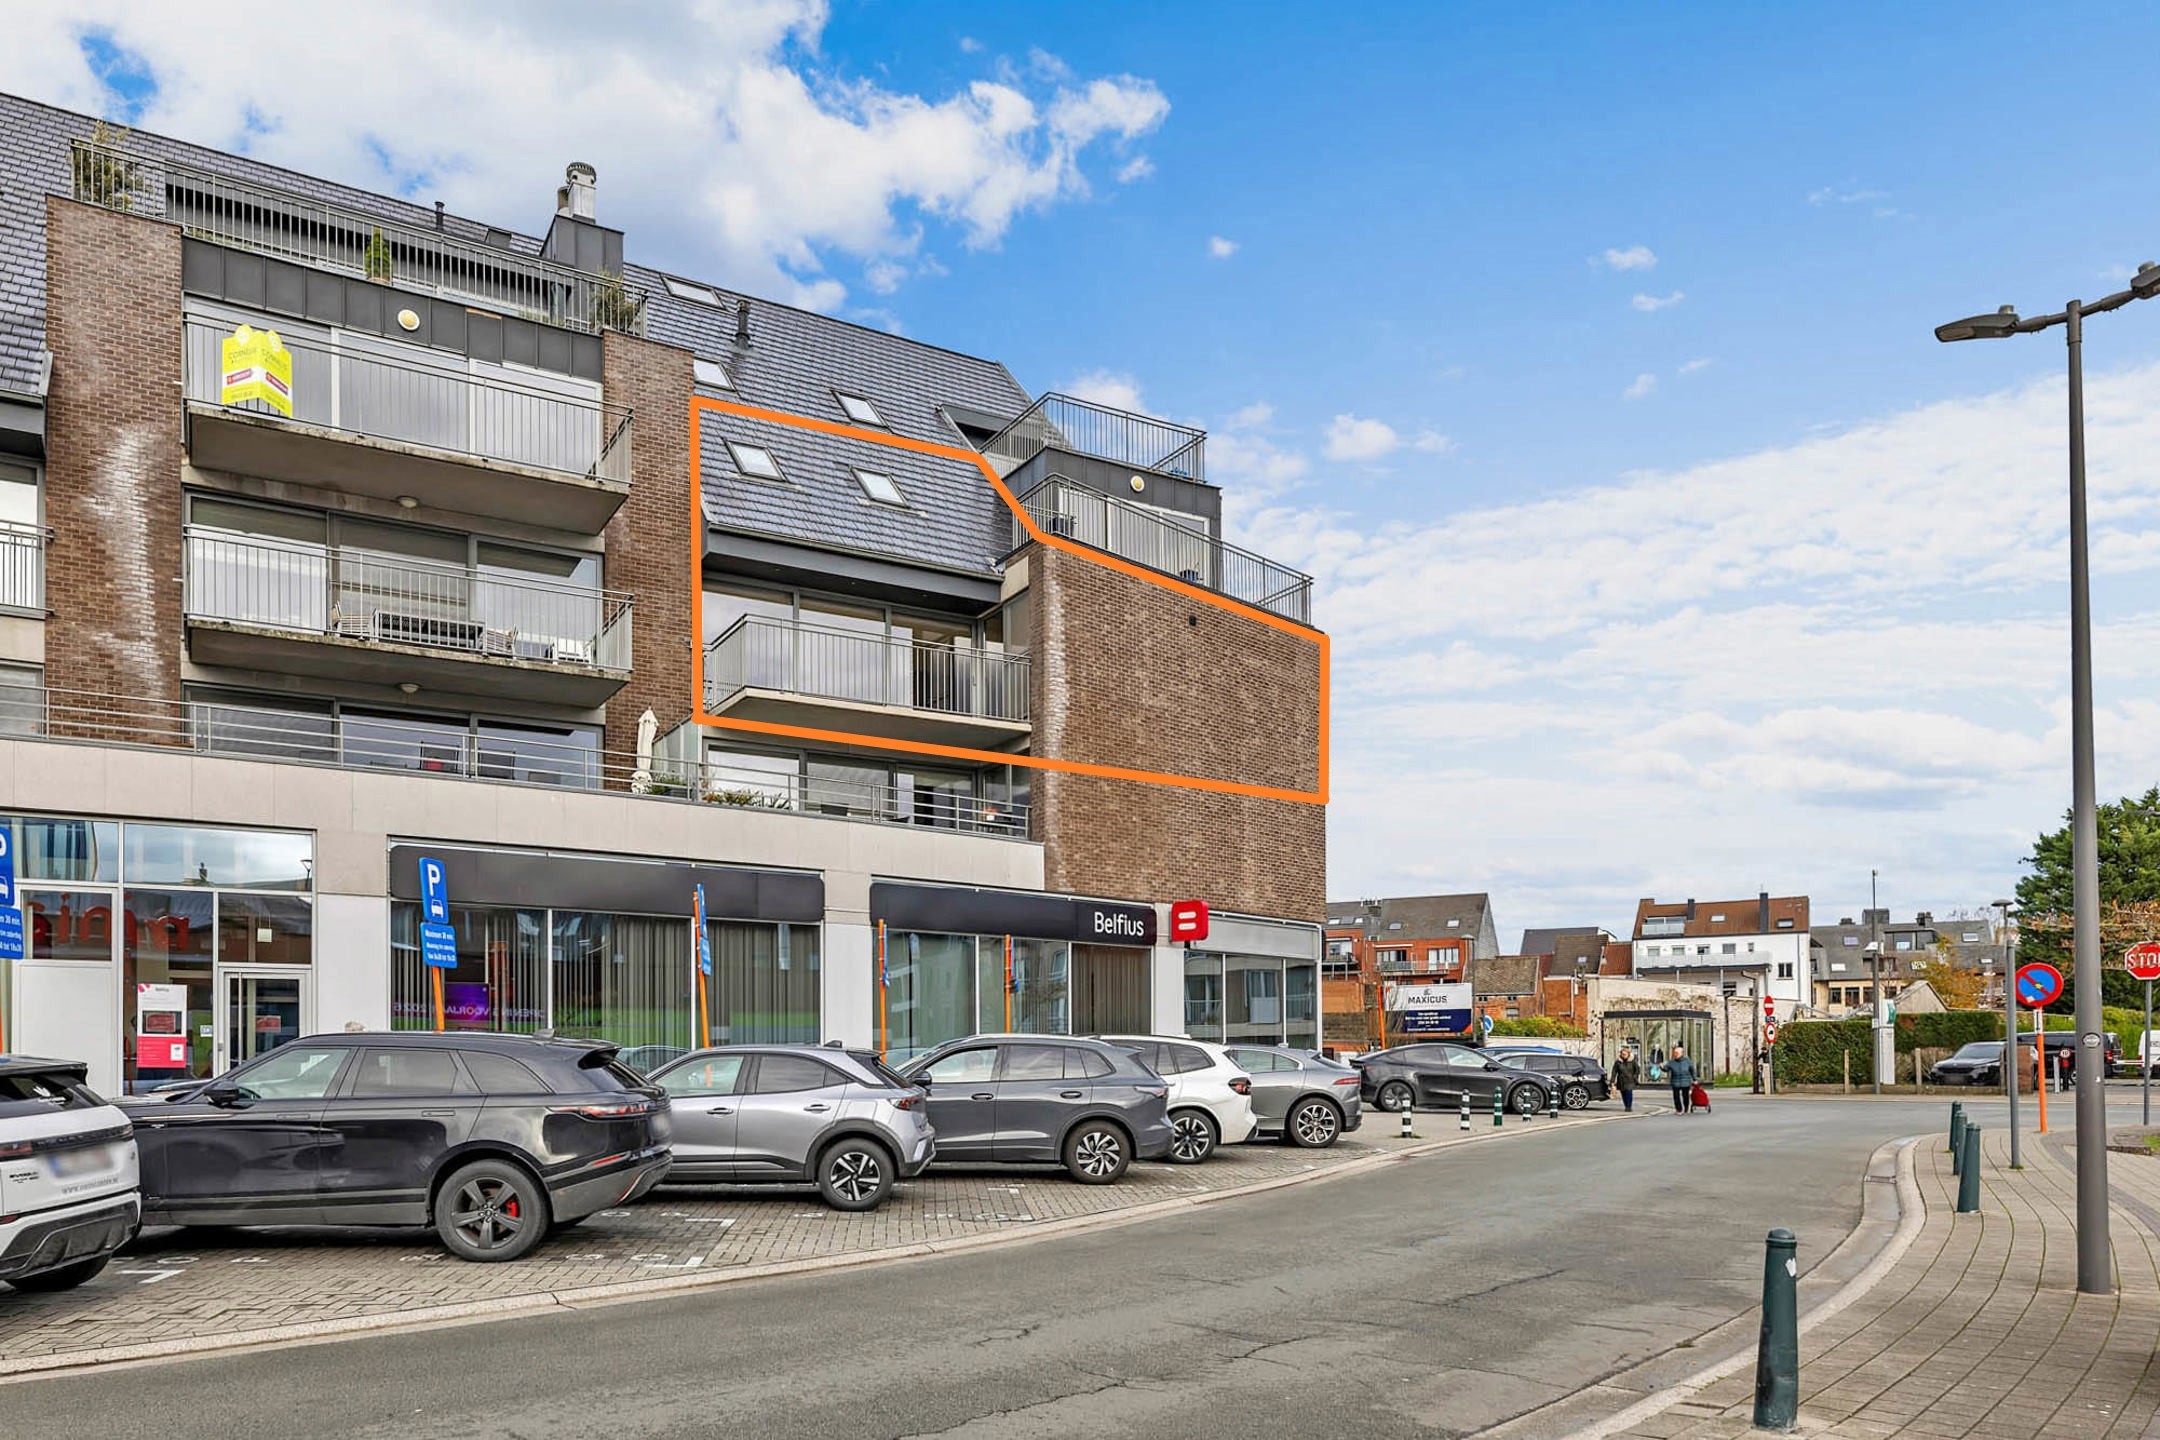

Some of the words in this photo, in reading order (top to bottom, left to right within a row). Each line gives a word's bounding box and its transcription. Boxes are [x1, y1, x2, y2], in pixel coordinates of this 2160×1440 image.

[427, 863, 441, 897] P
[1094, 911, 1145, 937] Belfius
[1408, 995, 1448, 1004] MAXICUS
